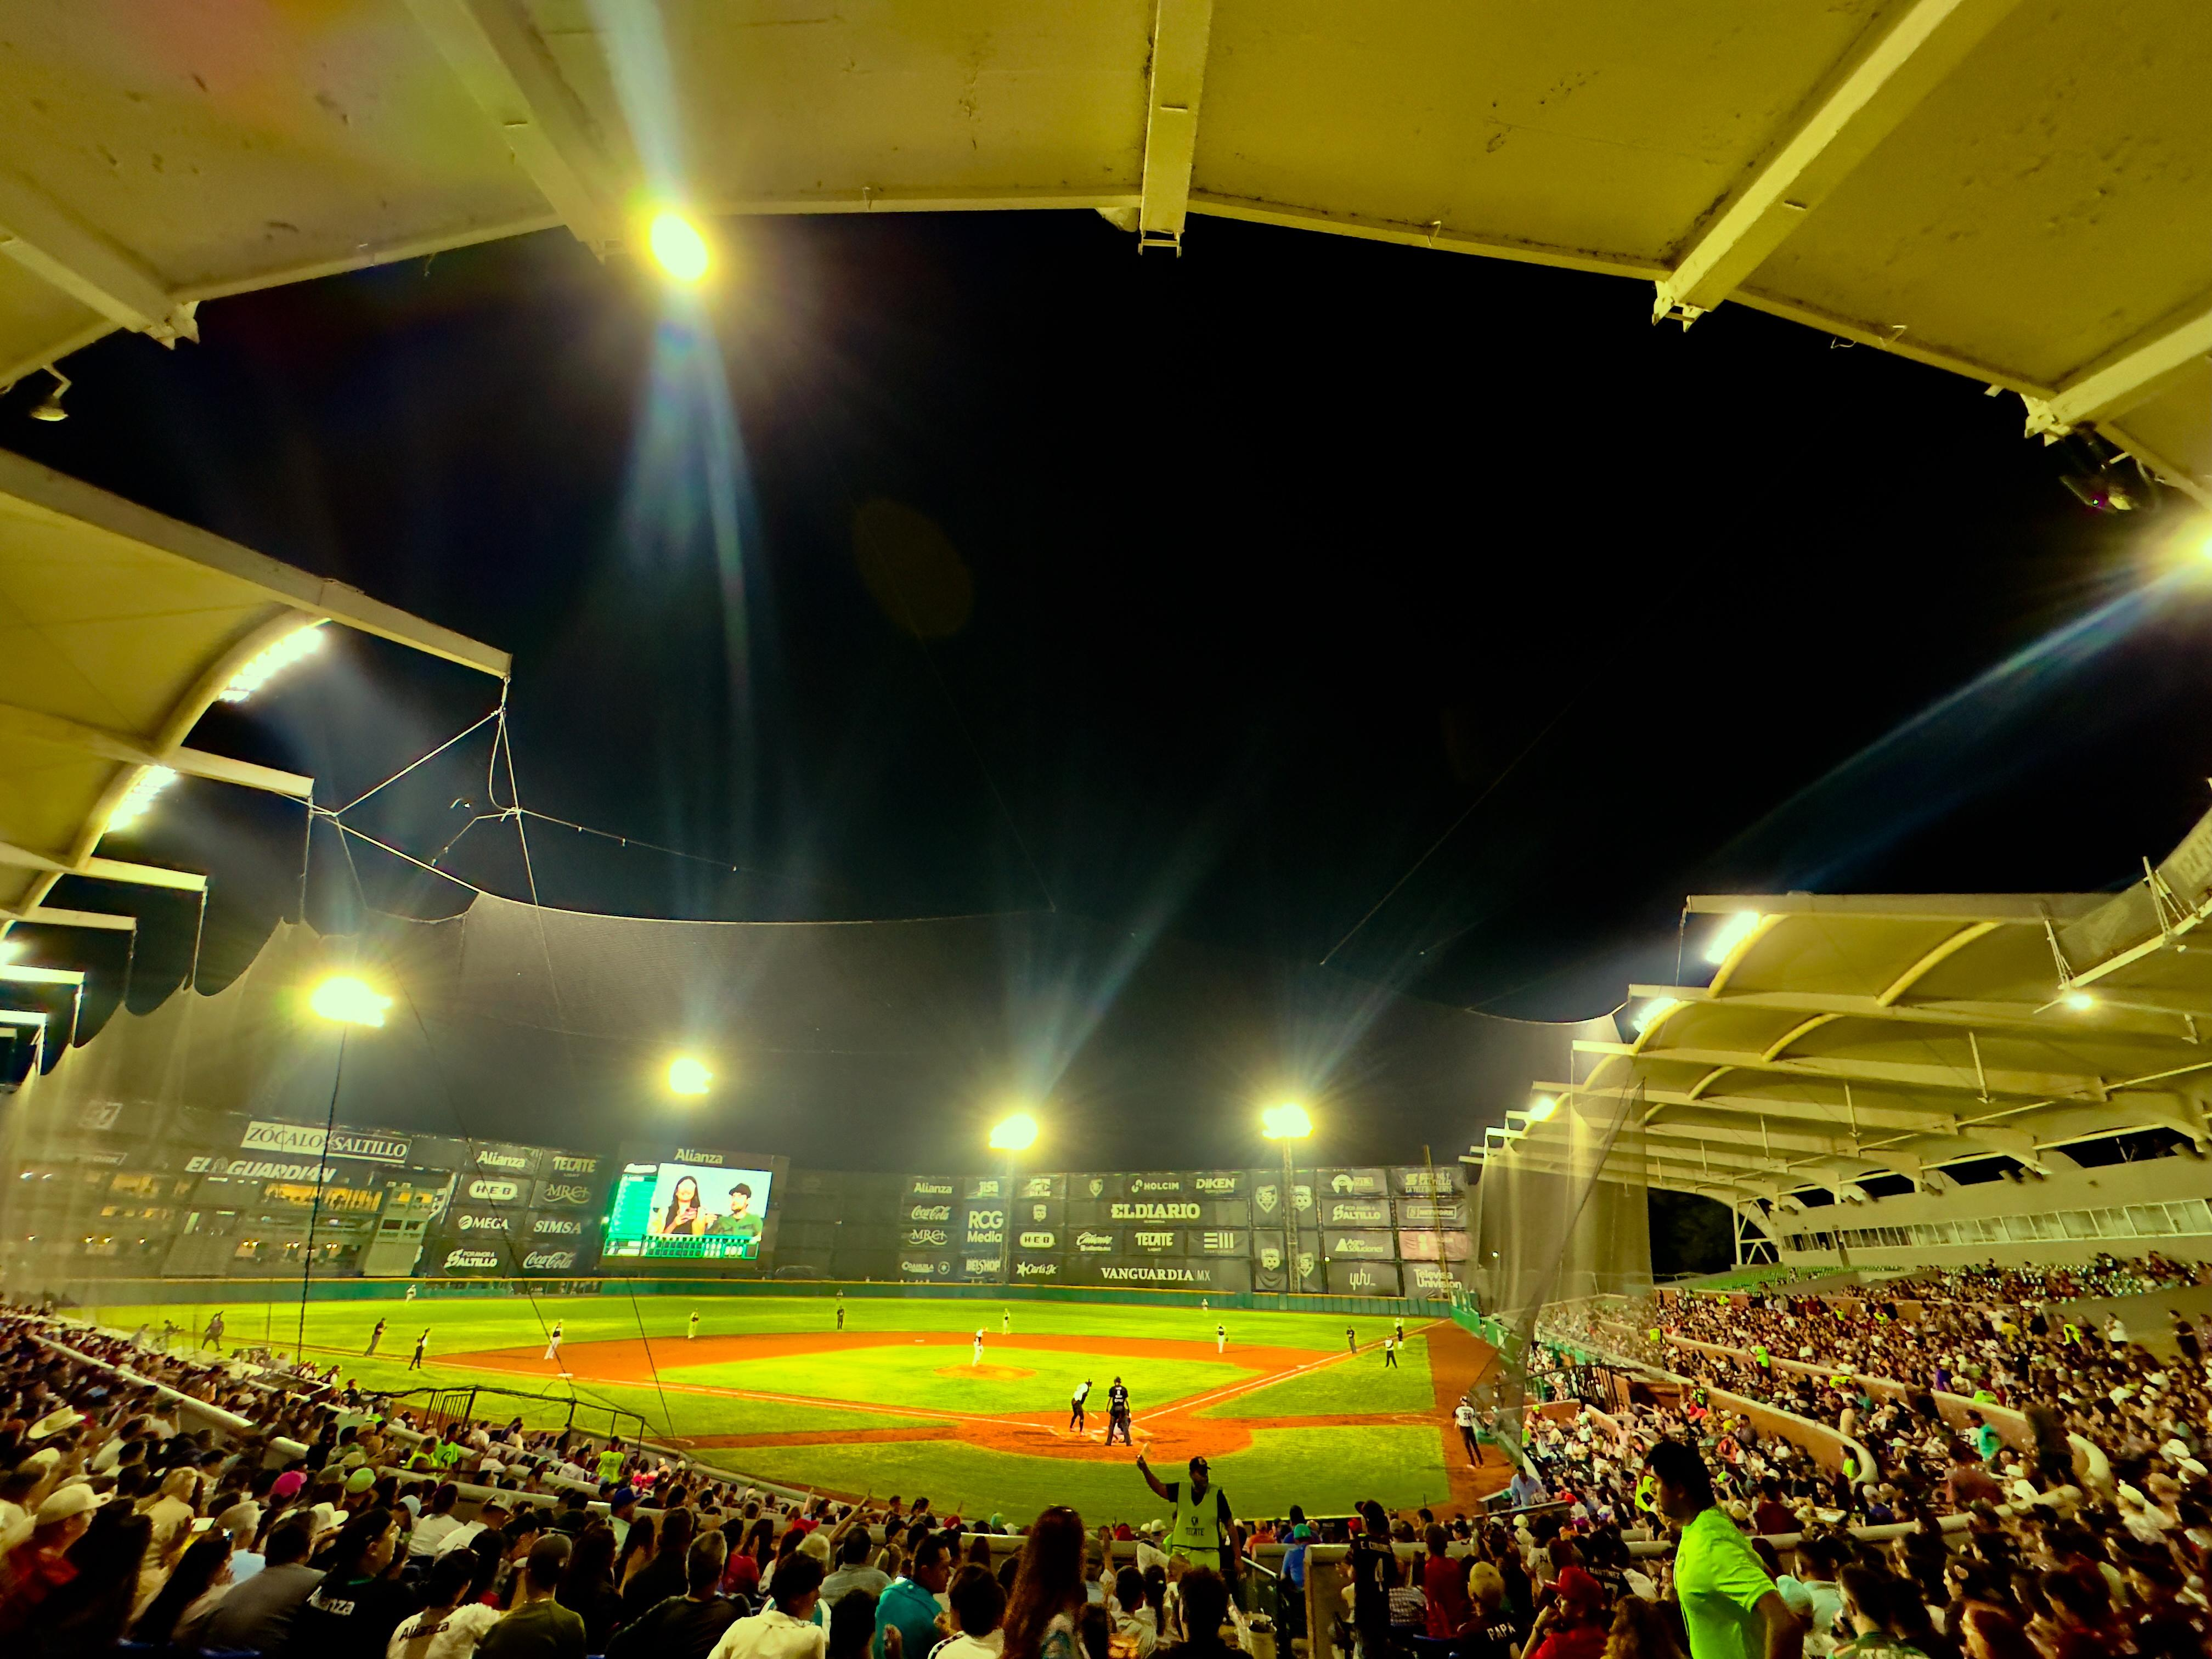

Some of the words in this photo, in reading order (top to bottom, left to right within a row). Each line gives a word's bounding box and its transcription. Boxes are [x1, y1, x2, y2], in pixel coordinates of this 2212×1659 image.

[247, 1126, 323, 1148] ZÓCALO
[332, 1137, 407, 1158] SALTILLO
[476, 1151, 526, 1168] Alianza
[674, 1148, 723, 1164] Alianza
[184, 1156, 212, 1173] EL
[227, 1160, 336, 1183] GUARDIÁN
[552, 1156, 596, 1173] TECATE
[913, 1182, 952, 1194] Alianza
[1144, 1182, 1179, 1190] HOLCIM
[1196, 1178, 1235, 1189] DIKEN
[968, 1210, 1004, 1229] RCG
[1333, 1204, 1381, 1221] SALTILLO
[533, 1220, 582, 1234] SIMSA
[967, 1231, 1002, 1243] Media
[1135, 1232, 1175, 1246] TECATE
[444, 1249, 498, 1268] SALTILLO
[1101, 1267, 1194, 1281] VANGUARDIA
[1197, 1270, 1211, 1281] MX
[1414, 1269, 1453, 1280] Televisa
[1417, 1278, 1462, 1290] Univision
[1186, 1527, 1205, 1536] TECATE
